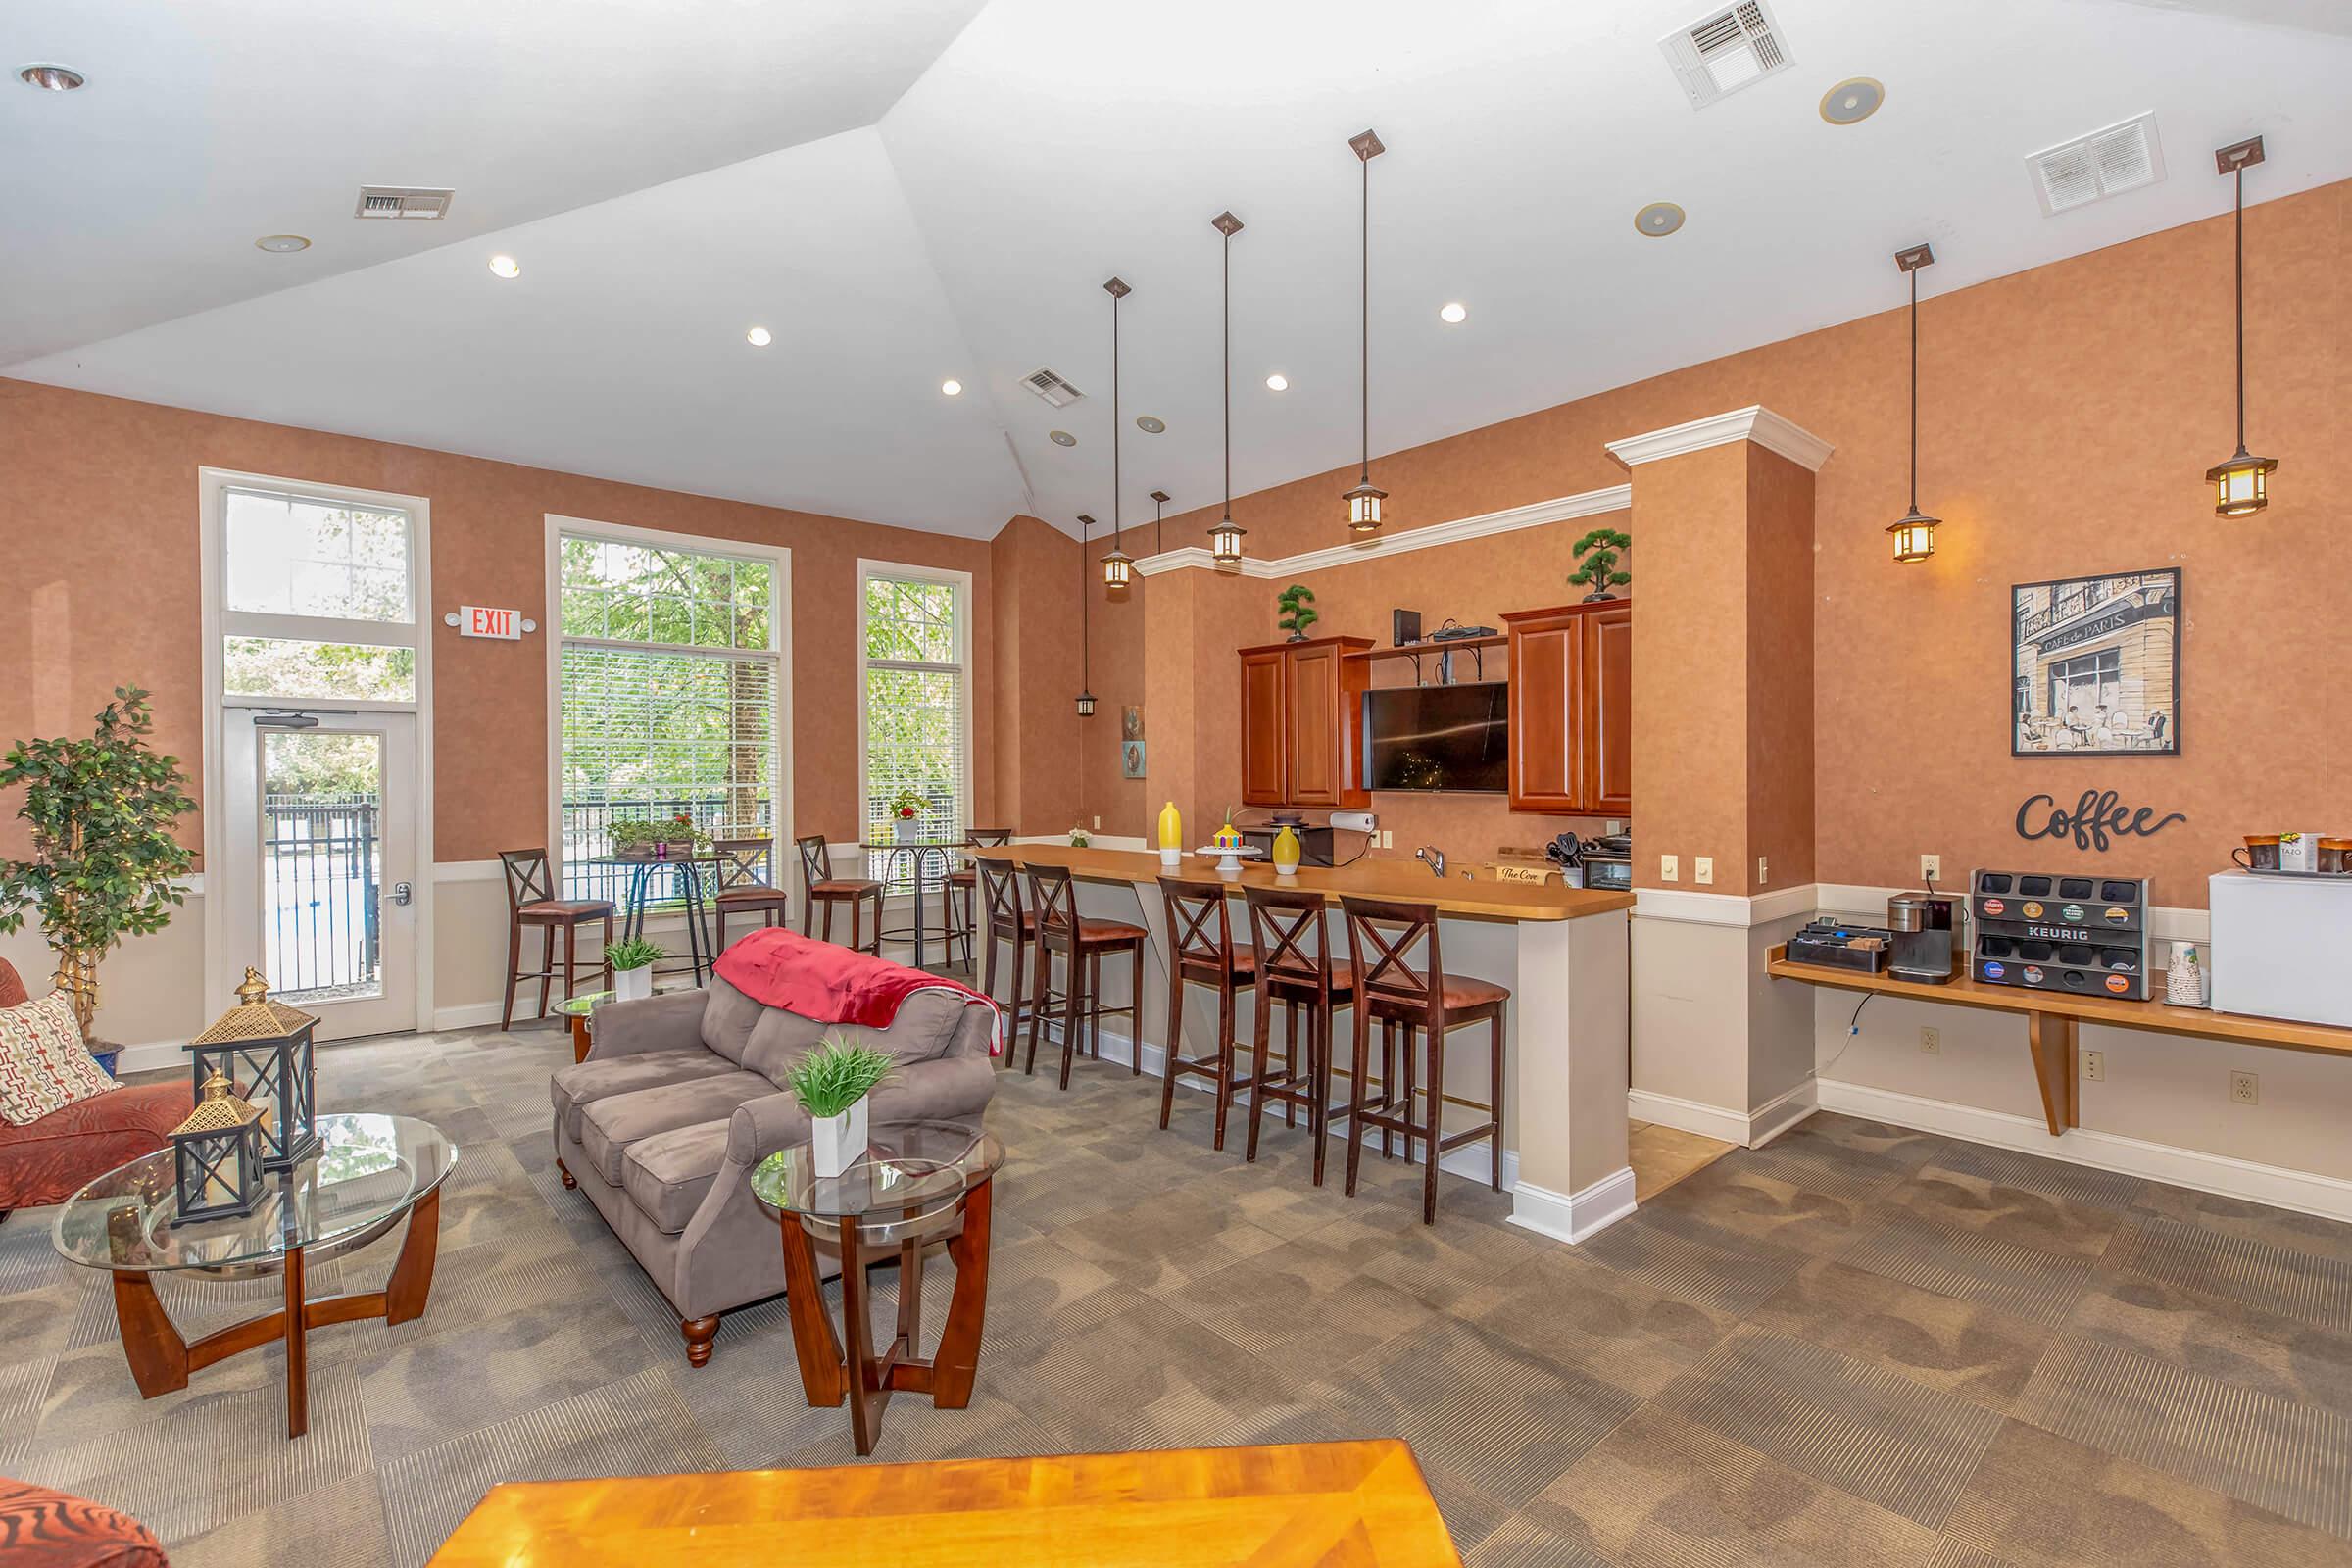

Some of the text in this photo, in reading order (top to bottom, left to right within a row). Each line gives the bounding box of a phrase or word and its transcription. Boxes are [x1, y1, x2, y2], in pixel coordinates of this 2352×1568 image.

[472, 609, 513, 636] EXIT
[2083, 613, 2126, 638] PARIS
[2016, 789, 2186, 852] Coffee
[1502, 867, 1538, 880] The Cove
[2029, 927, 2088, 941] KEURIG
